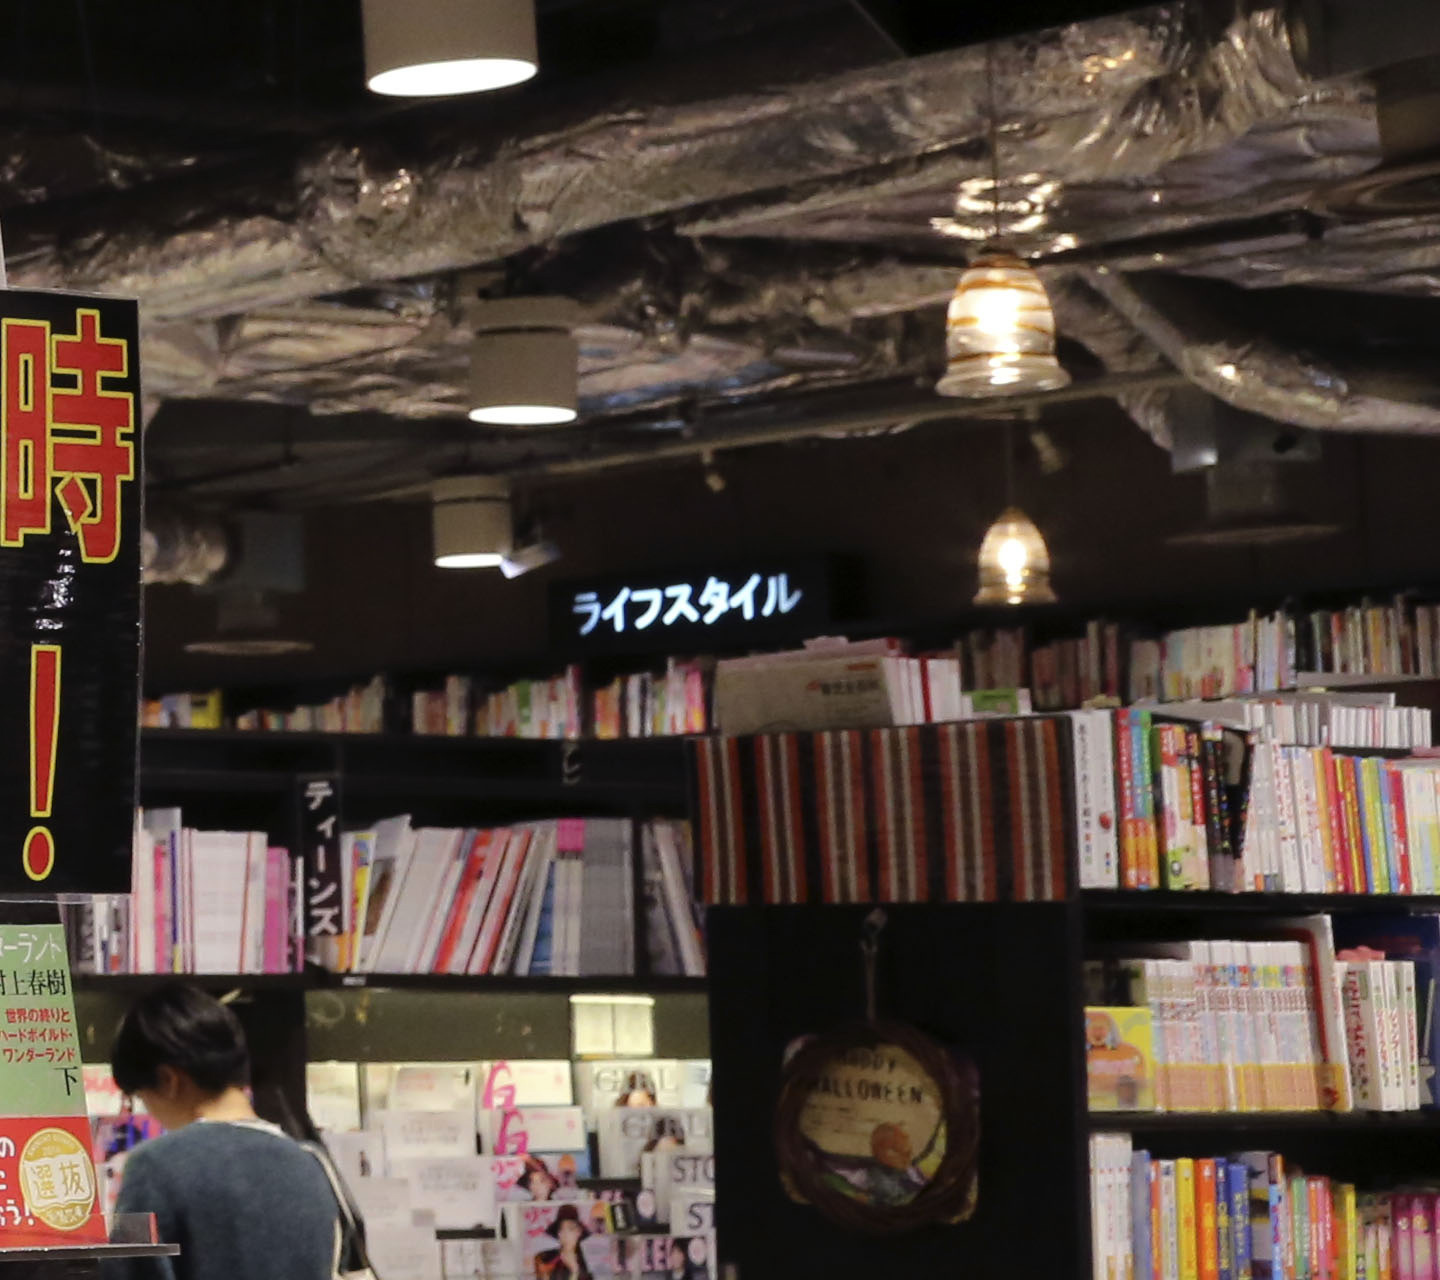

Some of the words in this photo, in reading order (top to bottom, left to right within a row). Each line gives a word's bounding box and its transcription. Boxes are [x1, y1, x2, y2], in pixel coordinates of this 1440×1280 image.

[572, 572, 804, 635] ライフスタイル
[304, 780, 338, 936] ティーンズ
[5, 1007, 71, 1024] 世界の終りと
[1, 1047, 76, 1064] ワンダーランド
